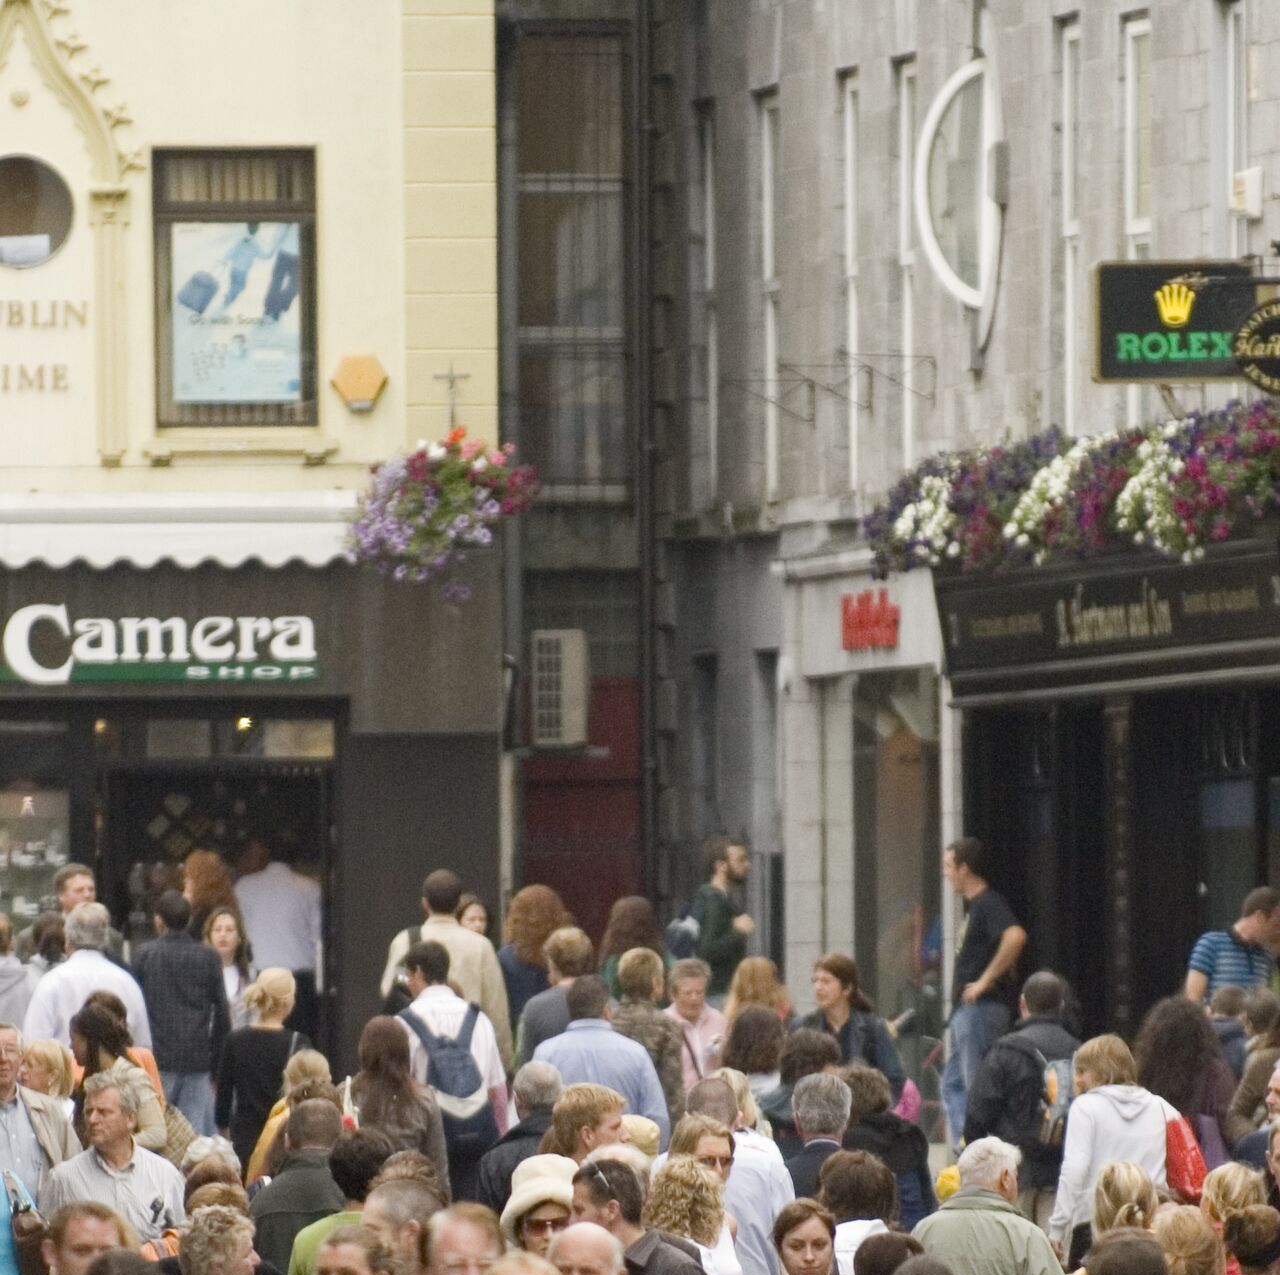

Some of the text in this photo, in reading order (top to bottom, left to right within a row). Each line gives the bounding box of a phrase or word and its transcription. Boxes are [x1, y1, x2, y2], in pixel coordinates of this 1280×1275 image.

[1115, 331, 1233, 361] ROLEX
[3, 603, 318, 685] Camera
[185, 665, 317, 679] SHOP
